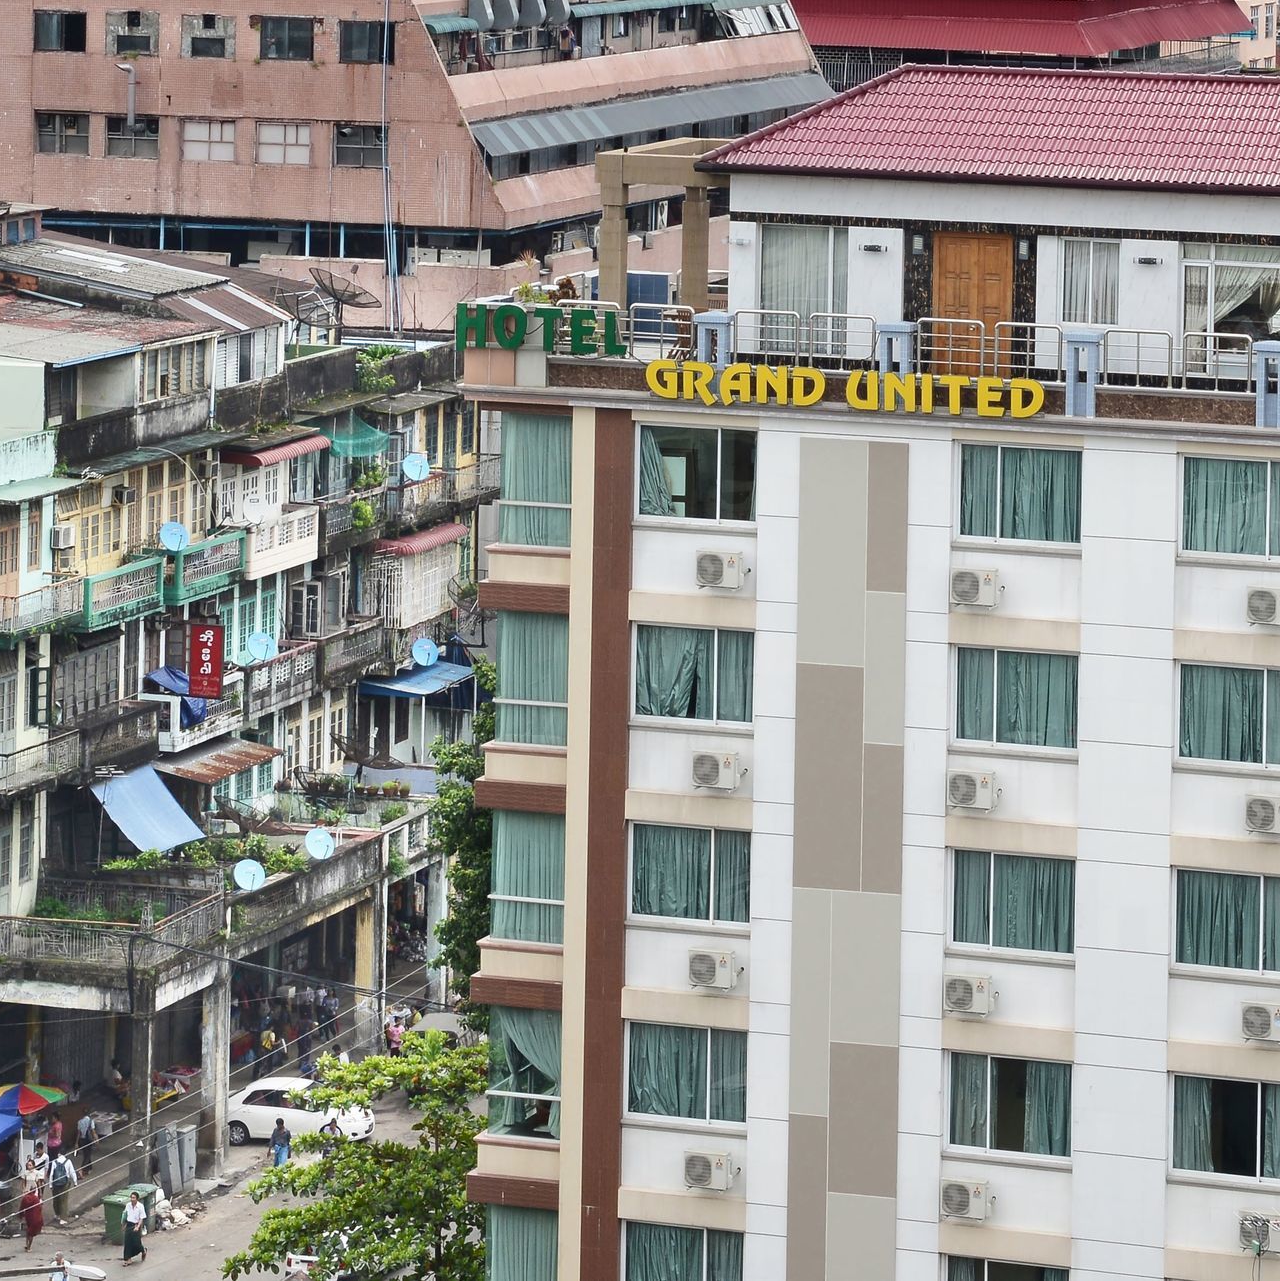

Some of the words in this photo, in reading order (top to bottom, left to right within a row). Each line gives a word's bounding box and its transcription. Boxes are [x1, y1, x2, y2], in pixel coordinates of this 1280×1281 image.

[455, 302, 628, 356] HOTEL
[645, 359, 826, 407] GRAND
[845, 370, 1045, 418] UNITED
